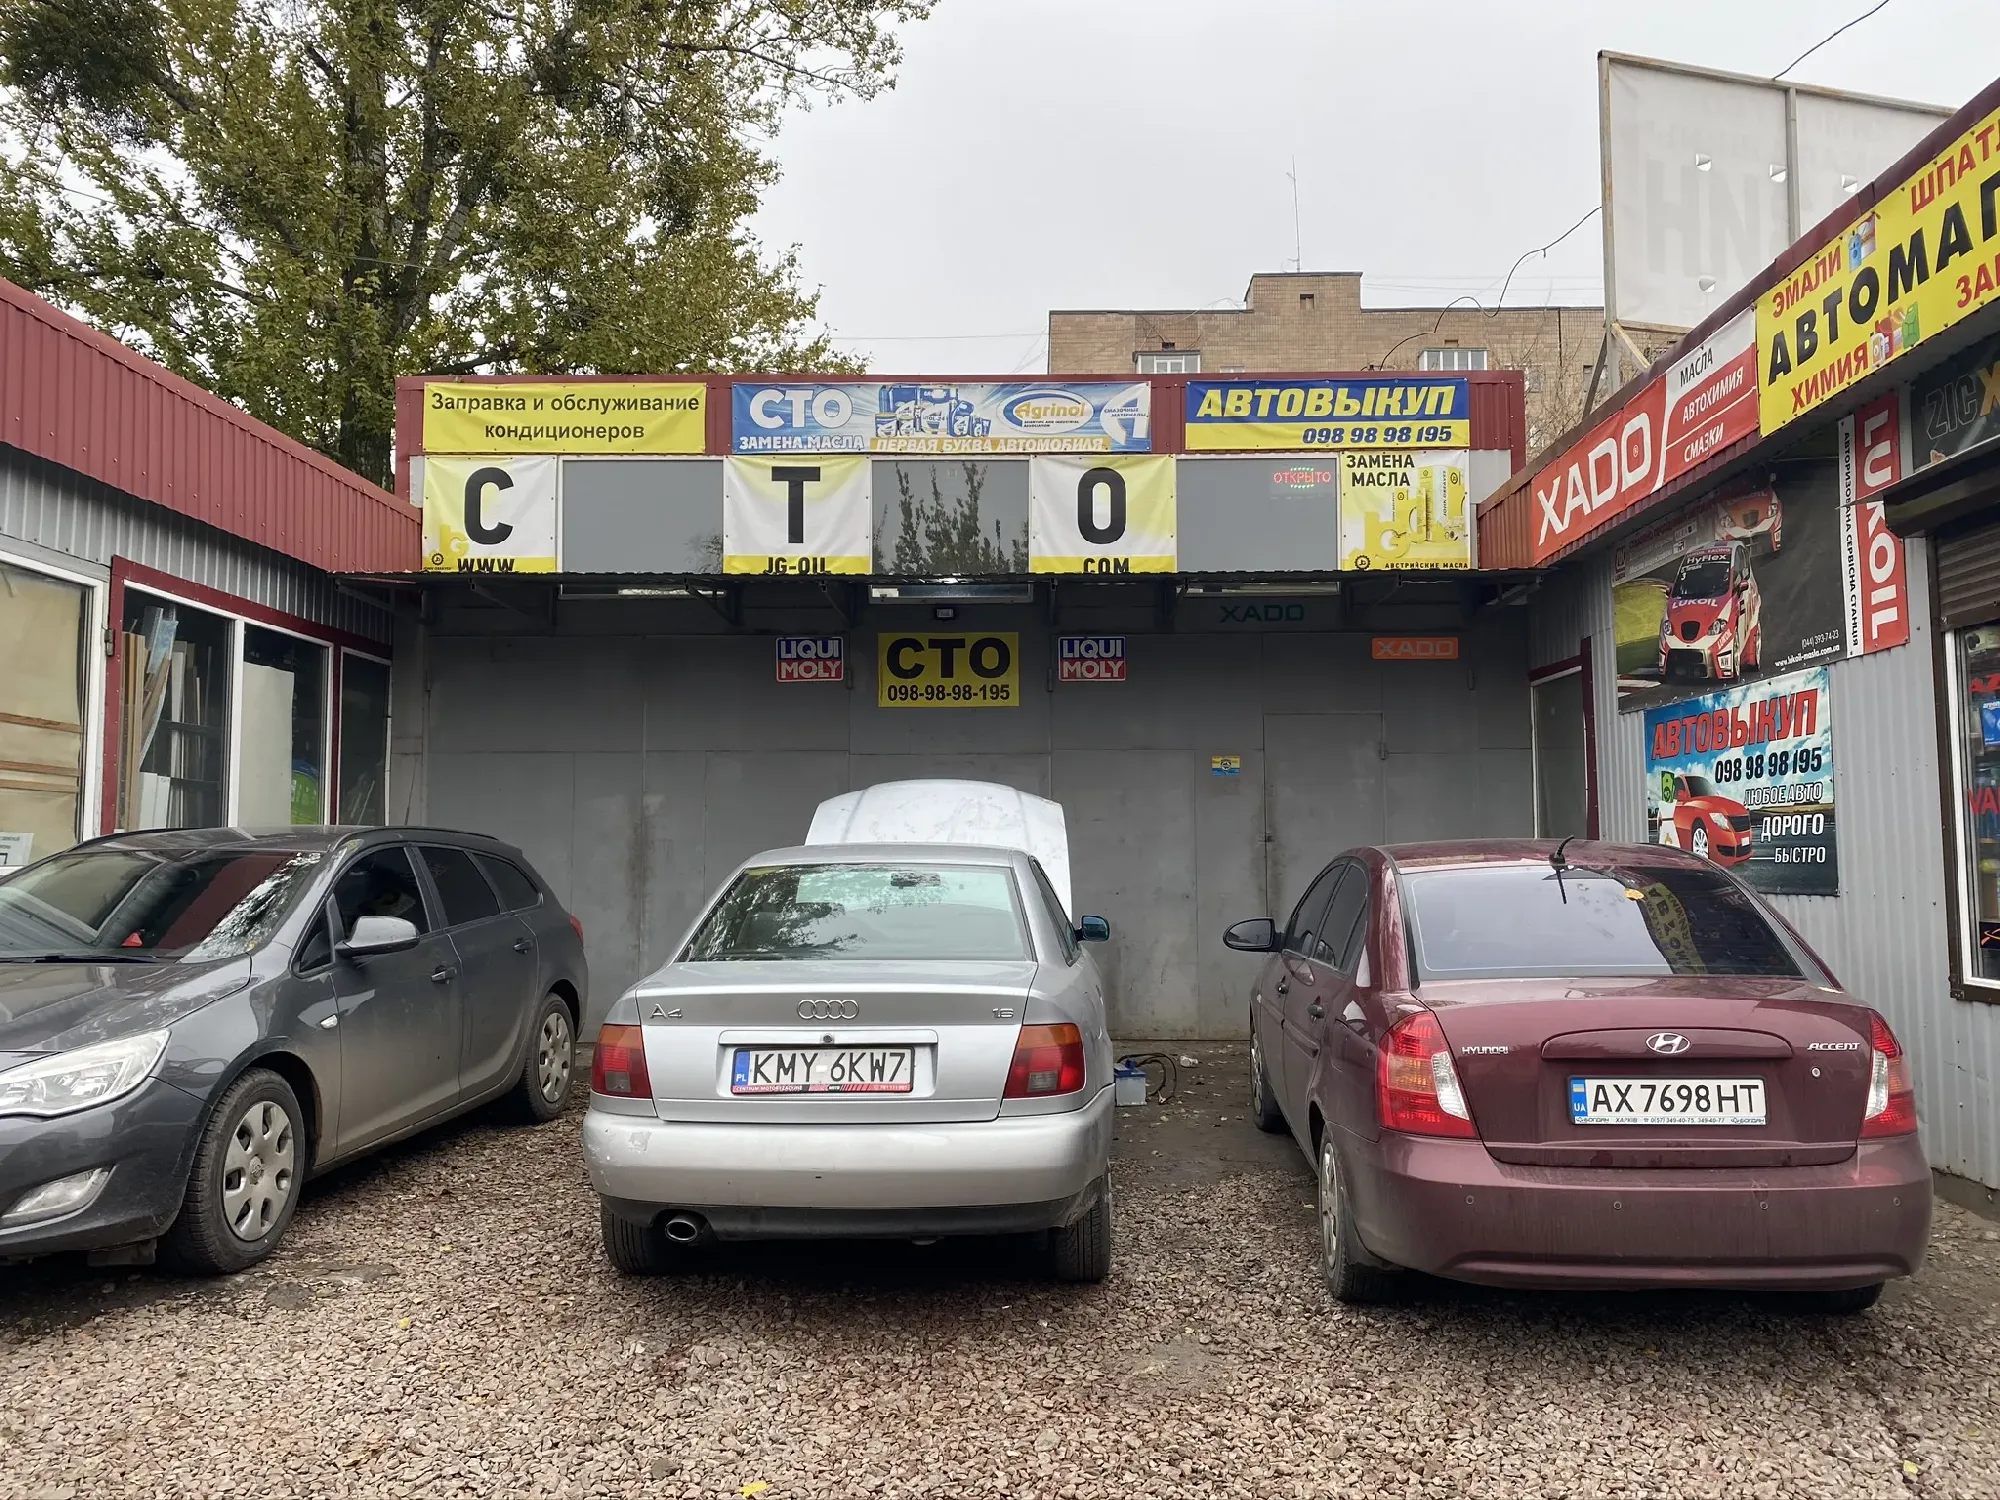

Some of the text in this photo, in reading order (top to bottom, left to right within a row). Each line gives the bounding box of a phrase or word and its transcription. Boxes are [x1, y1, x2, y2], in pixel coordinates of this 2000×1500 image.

[1772, 245, 1842, 318] ЭМАЛИ
[1680, 349, 1714, 387] МАСЛА
[1791, 341, 1868, 414] ХИМИЯ
[431, 392, 700, 415] Заправка и обслуживание
[1196, 386, 1456, 418] АВТОВЫКУП
[1682, 366, 1744, 425] АВТОХИМИЯ
[749, 388, 853, 429] СТО
[1015, 402, 1086, 419] Agrinol
[1926, 374, 1978, 440] ZIC
[485, 424, 644, 442] кондиционеров
[1302, 425, 1452, 444] 098 98 98 195
[1684, 423, 1724, 462] СМАЗКИ
[877, 438, 1104, 452] ПЕРВАЯ БУКВА АВТОМОБИЛЯ
[1346, 455, 1415, 468] ЗАМЕНА
[1273, 471, 1332, 483] ОТКРЫТО
[1351, 472, 1410, 486] МАСЛА
[1537, 412, 1651, 546] XADO
[464, 466, 514, 545] С
[771, 466, 821, 544] Т
[457, 558, 515, 571] WWW
[764, 557, 831, 574] JG-OIL
[1687, 554, 1727, 564] HyFlex
[1846, 534, 1856, 592] СЕРВІСНА
[1672, 598, 1718, 609] LUKOIL
[1220, 604, 1304, 623] XADO
[1850, 594, 1859, 646] СТАНЦІЯ
[780, 639, 839, 658] LIQUI
[1062, 639, 1122, 658] LIQUI
[1376, 640, 1454, 656] XADO
[886, 637, 1011, 679] СТО
[781, 660, 842, 678] MOLY
[1063, 660, 1123, 678] MOLY
[887, 684, 1010, 701] 098-98-98-195
[1651, 688, 1818, 761] АВТОВЫКУП
[1715, 747, 1822, 783] 098 98 98 195
[1743, 781, 1823, 807] ЛЮБОЕ АВТО
[1761, 813, 1825, 843] ДОРОГО
[1774, 847, 1826, 863] БЫСТРО
[650, 1003, 682, 1019] A4
[1461, 1046, 1509, 1054] HYUNDAI
[1807, 1042, 1860, 1050] ACCENT
[753, 1052, 906, 1083] KMY 6KW7
[735, 1074, 747, 1082] PL
[1574, 1103, 1586, 1111] UA
